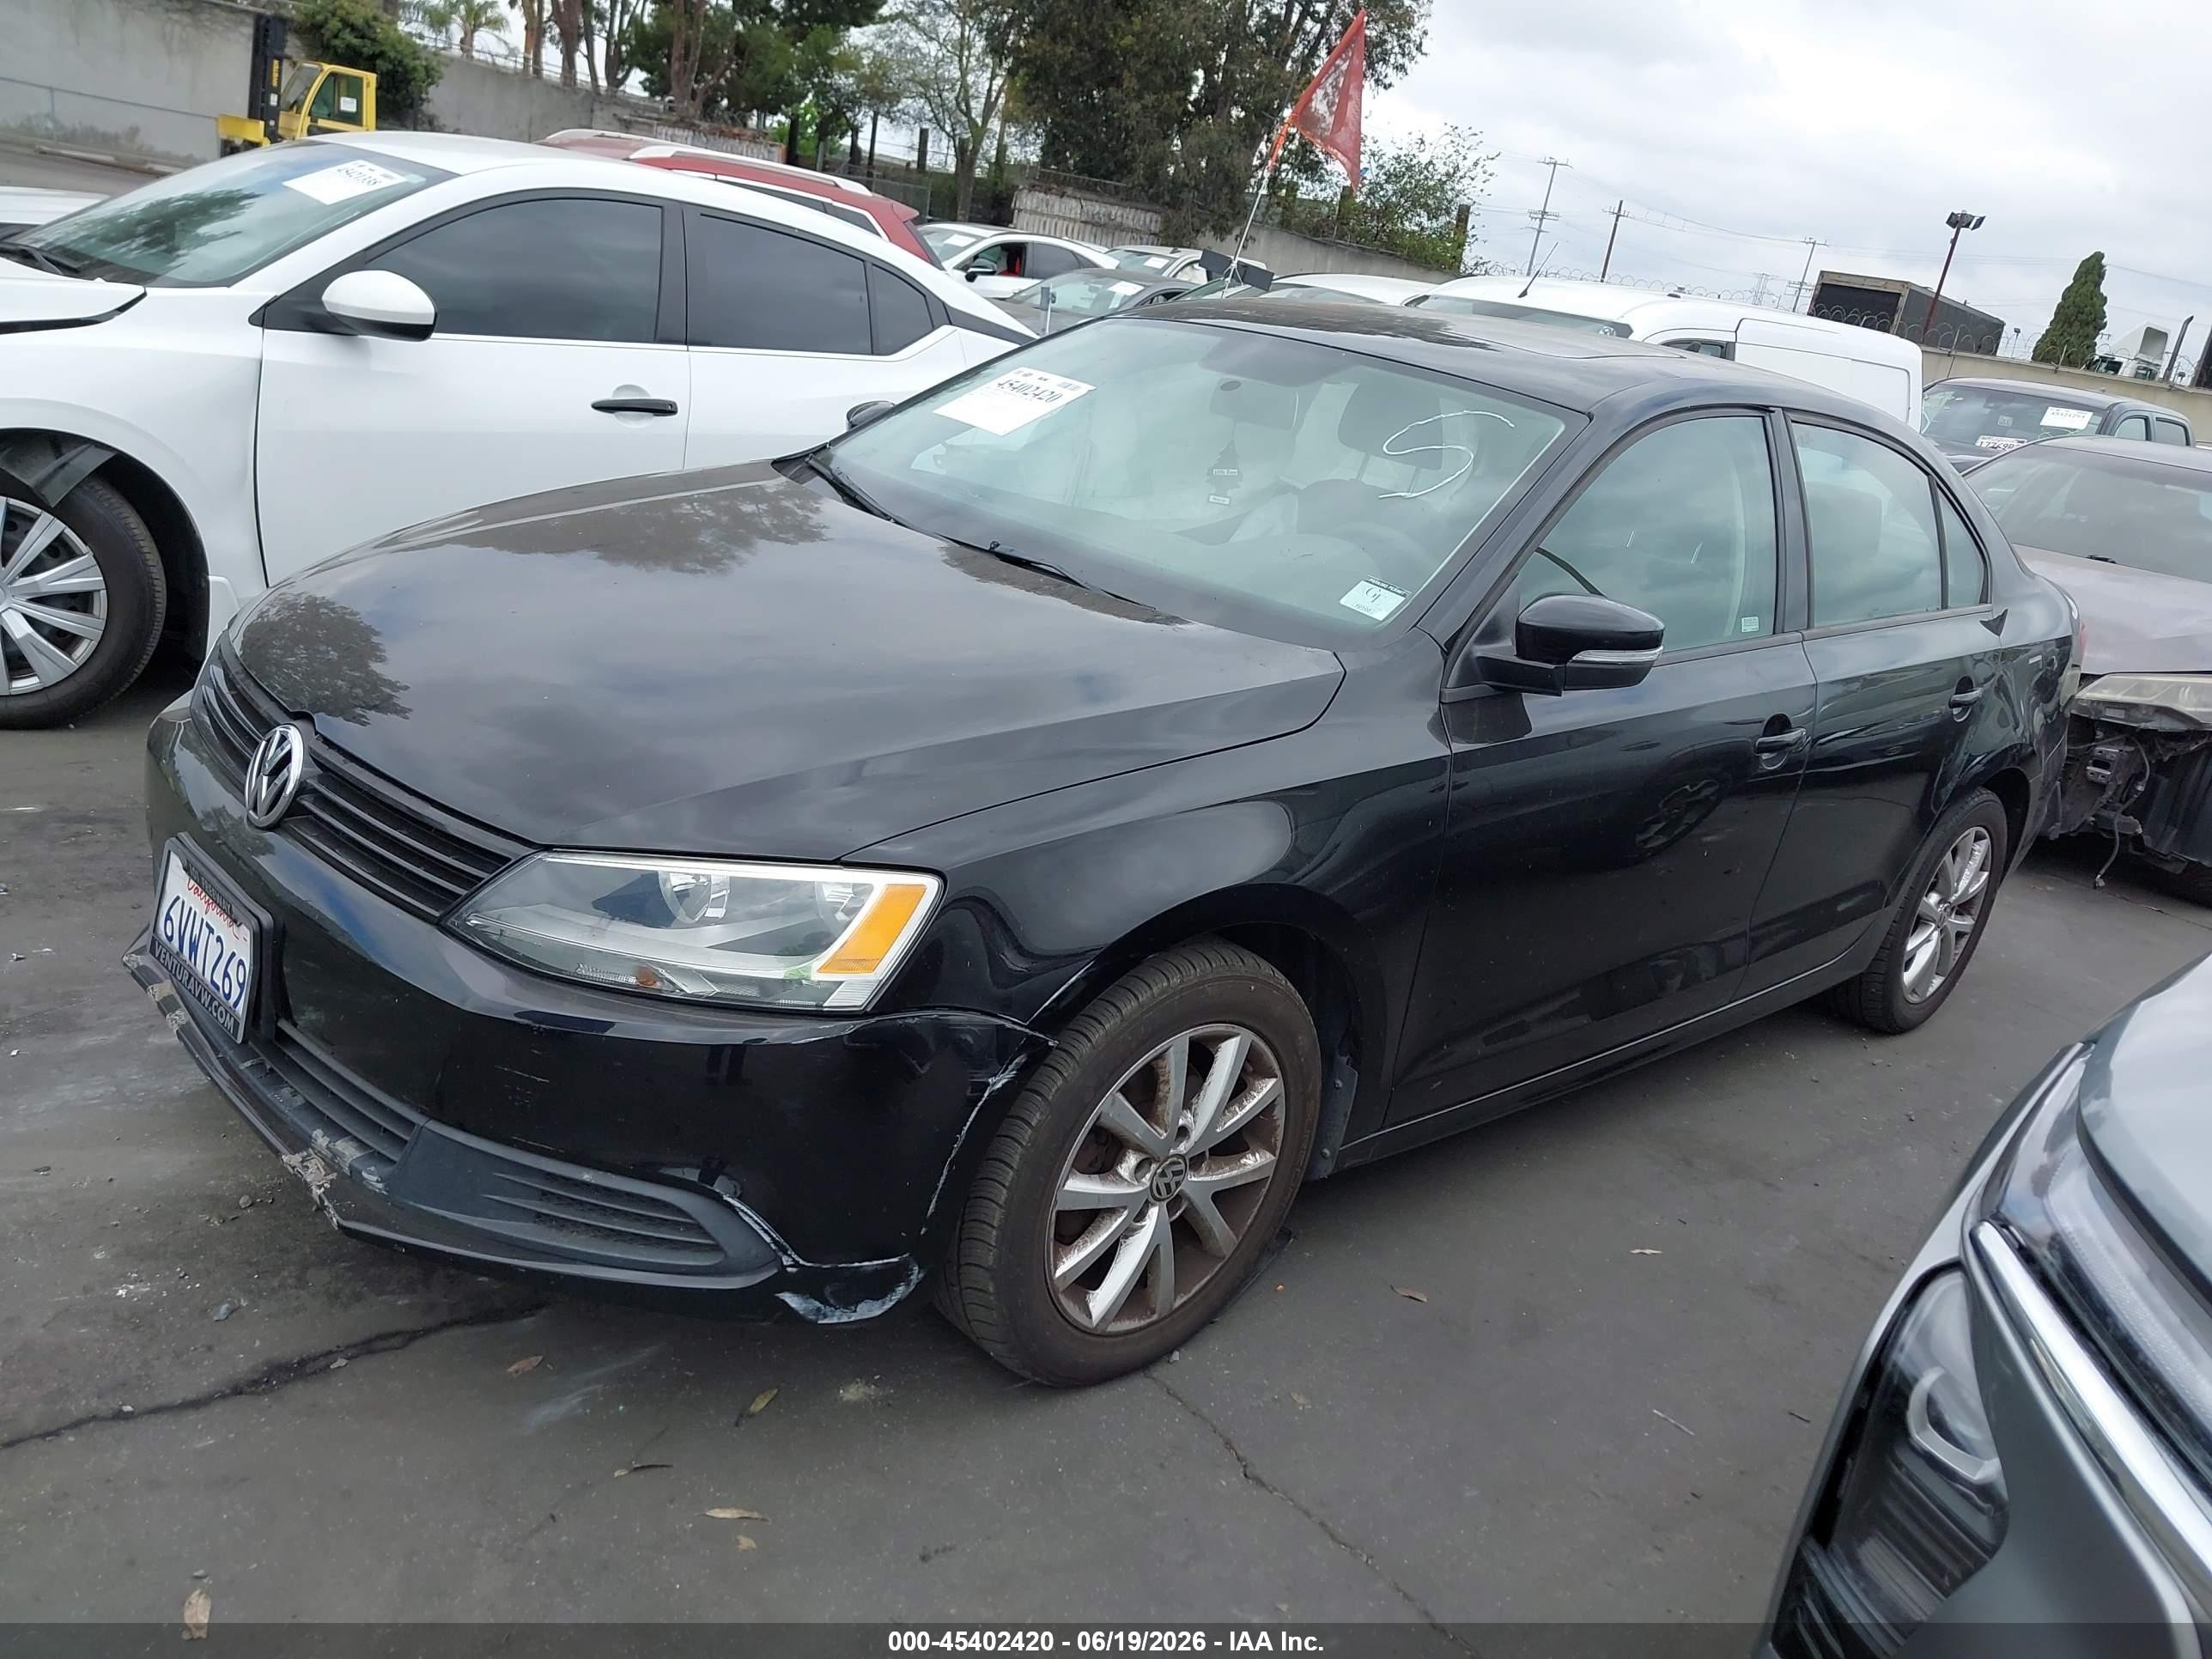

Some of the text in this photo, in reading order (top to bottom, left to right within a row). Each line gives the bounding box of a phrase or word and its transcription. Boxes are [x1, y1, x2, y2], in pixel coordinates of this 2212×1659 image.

[997, 379, 1064, 404] 45402420
[154, 942, 235, 1035] VENTURAVW.COM
[163, 896, 247, 1010] 6VWT269
